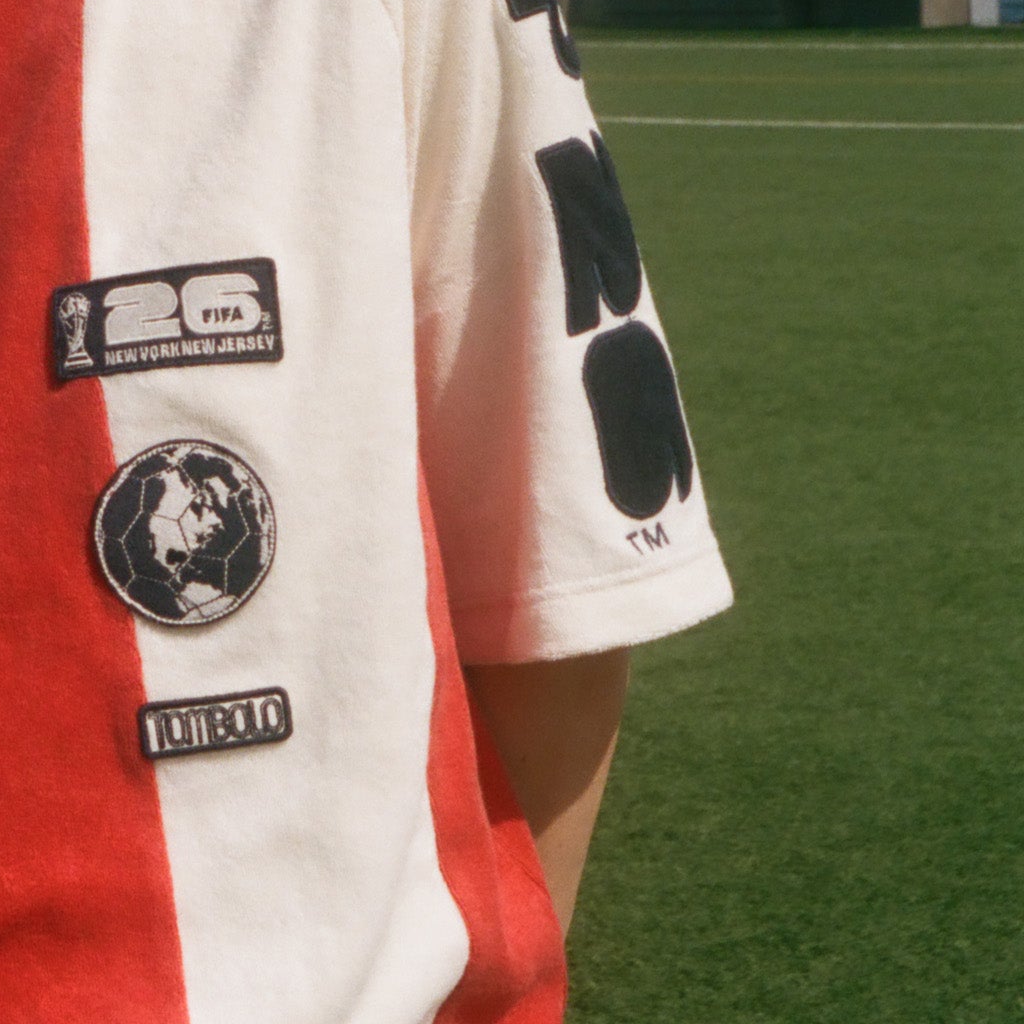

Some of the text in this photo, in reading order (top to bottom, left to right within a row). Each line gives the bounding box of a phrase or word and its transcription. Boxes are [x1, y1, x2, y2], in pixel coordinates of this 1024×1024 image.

[104, 273, 262, 346] 26
[202, 306, 244, 324] FIFA
[105, 333, 275, 366] NEW YORK NEW JERSEY
[625, 522, 670, 555] TM
